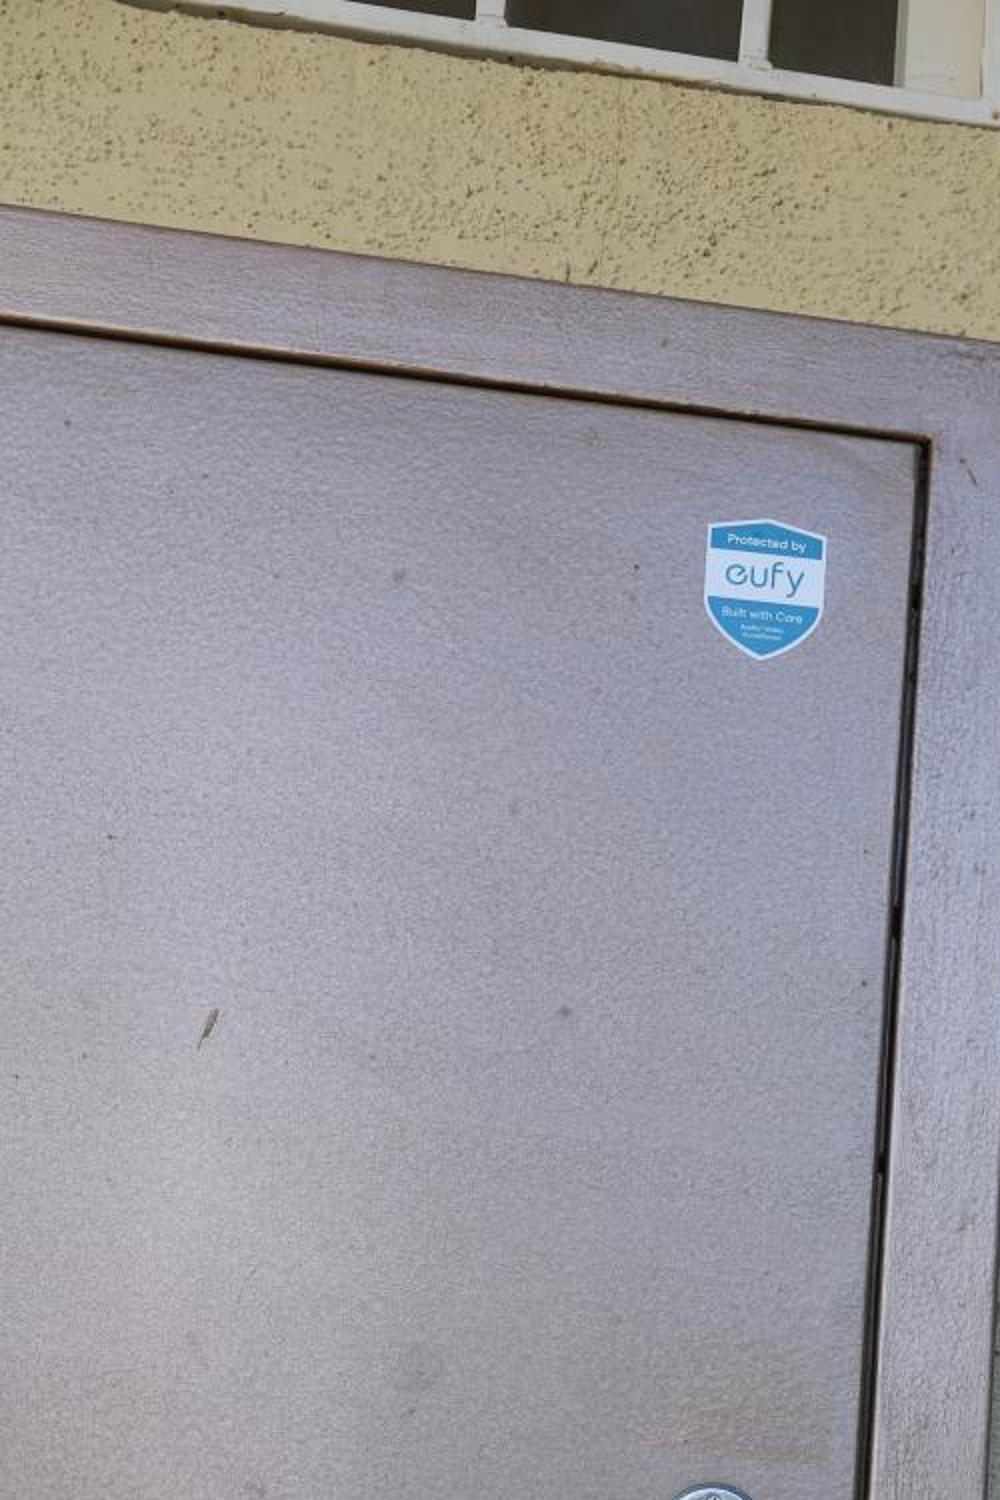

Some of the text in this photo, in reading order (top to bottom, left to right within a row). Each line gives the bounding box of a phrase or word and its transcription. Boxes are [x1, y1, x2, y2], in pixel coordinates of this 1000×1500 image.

[727, 533, 807, 553] Protected by
[725, 561, 805, 599] eufy
[721, 605, 747, 618] Built
[776, 611, 803, 625] Care
